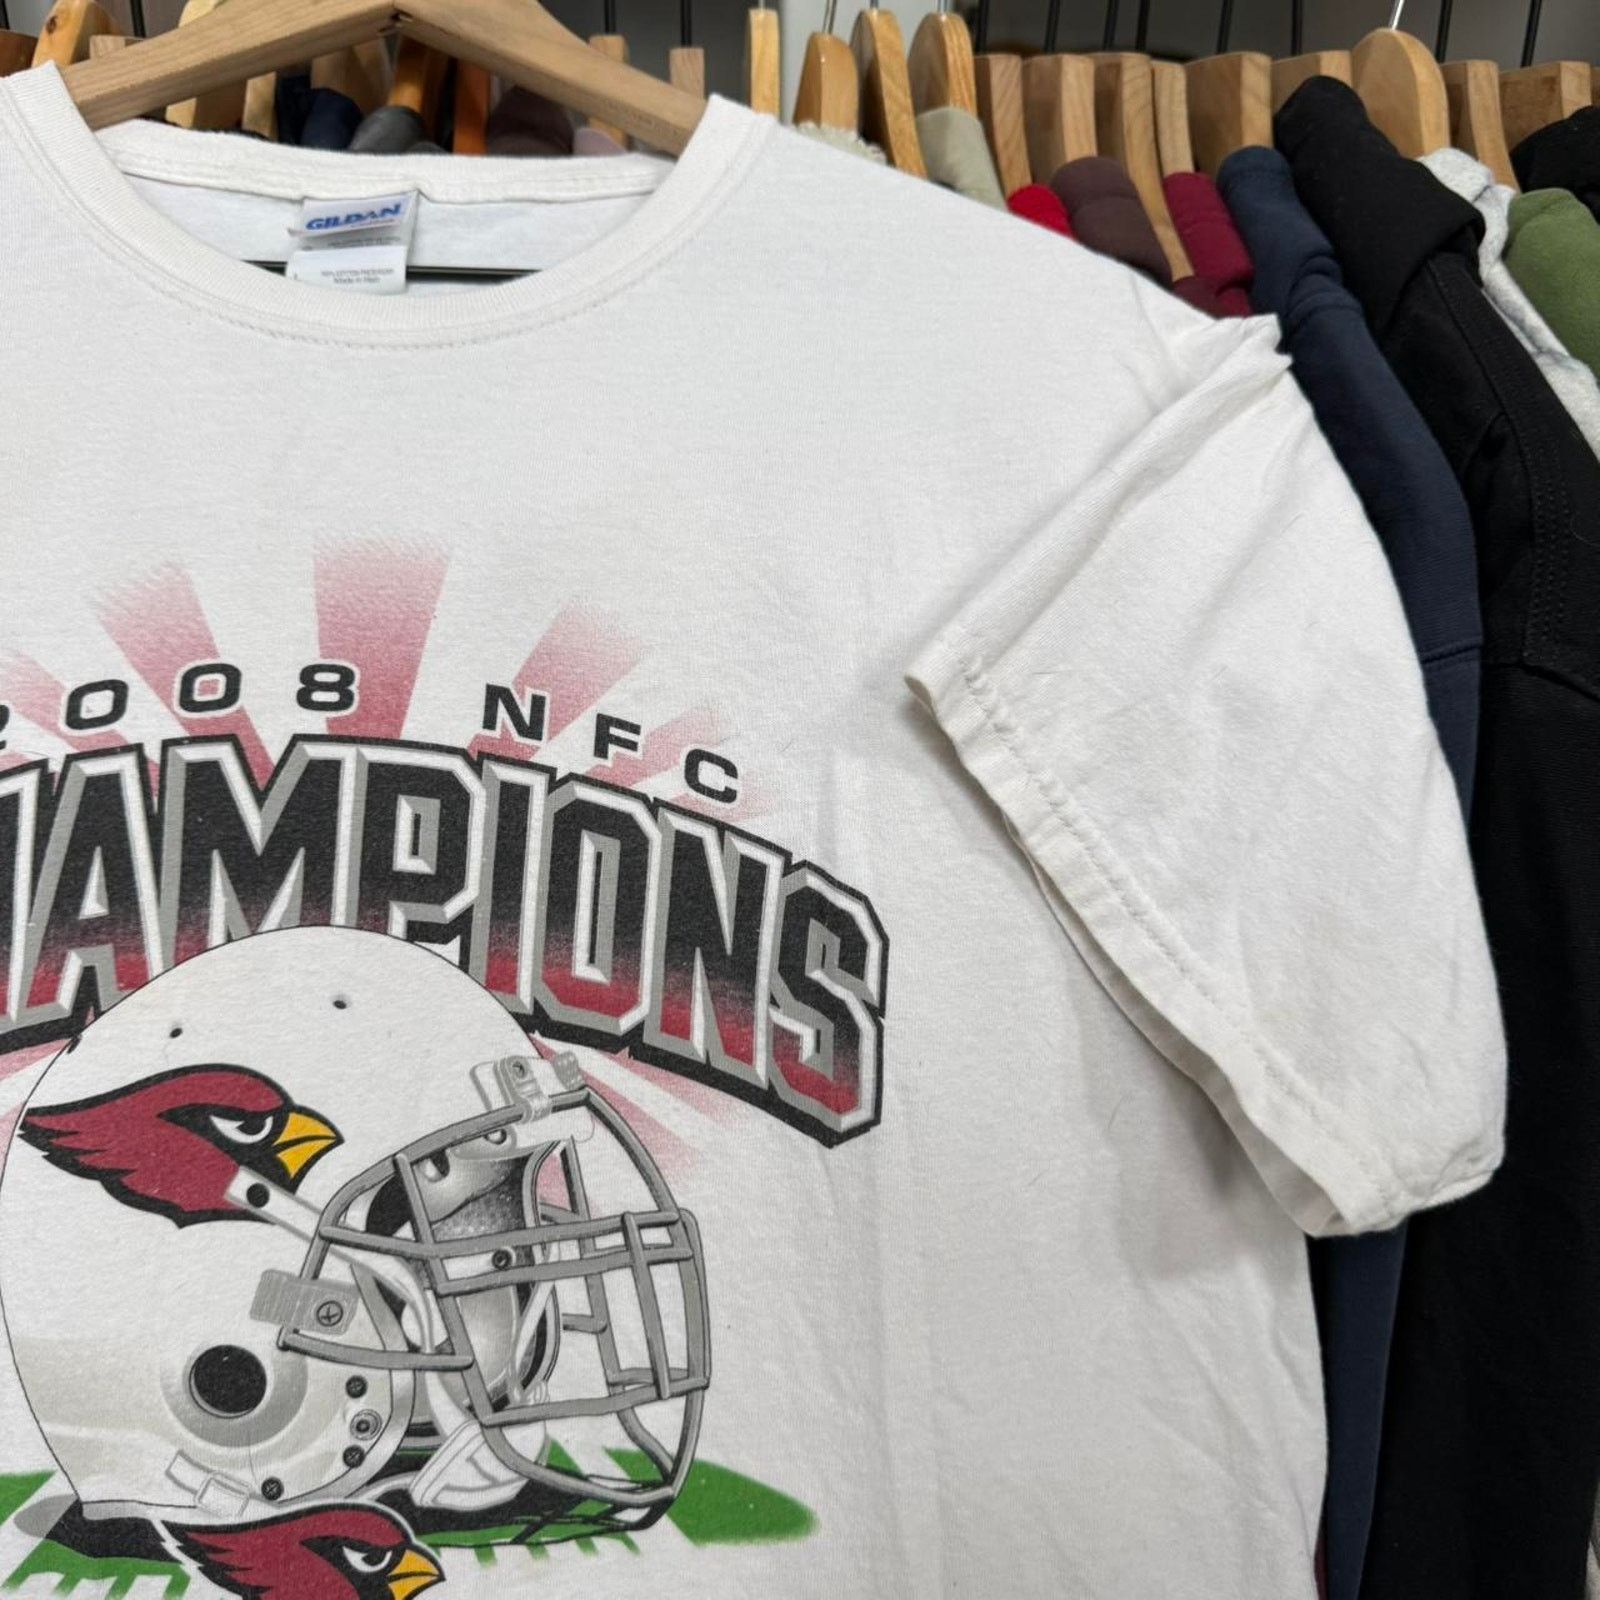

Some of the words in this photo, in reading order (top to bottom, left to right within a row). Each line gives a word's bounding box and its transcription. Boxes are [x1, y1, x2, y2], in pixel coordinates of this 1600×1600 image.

[306, 203, 401, 230] GILDAN
[0, 662, 357, 752] 008
[484, 684, 741, 804] NFC
